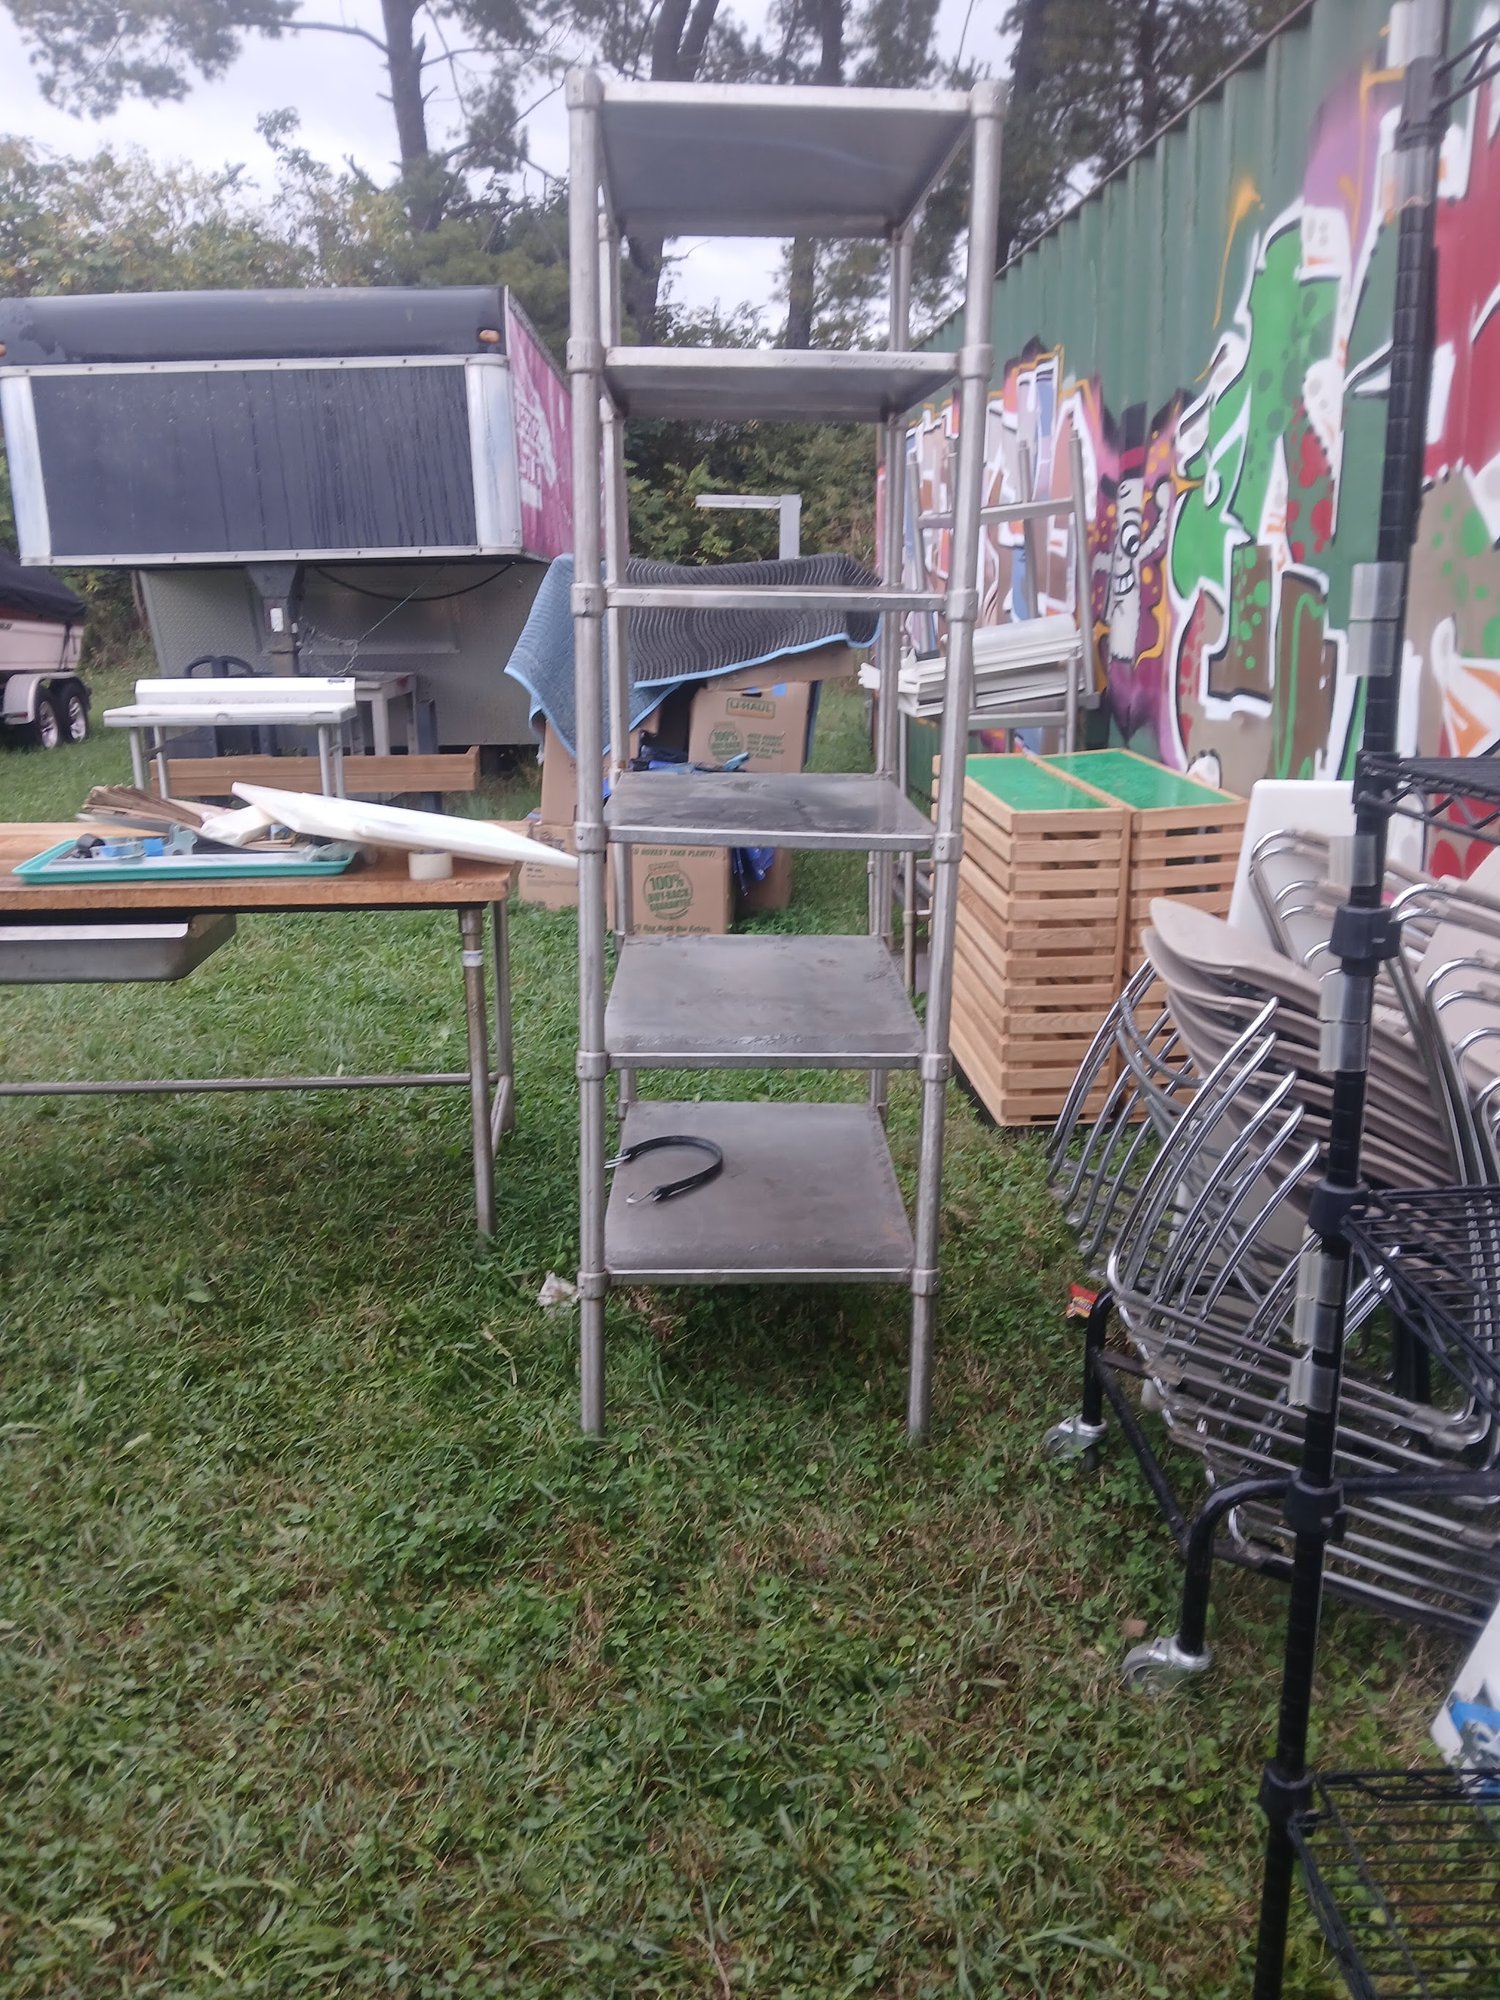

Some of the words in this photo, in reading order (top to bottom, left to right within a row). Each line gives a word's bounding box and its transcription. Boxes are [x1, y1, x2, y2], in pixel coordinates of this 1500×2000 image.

[730, 700, 772, 714] U-HAUL
[649, 872, 684, 891] 100%
[647, 888, 690, 903] BUY-BACK
